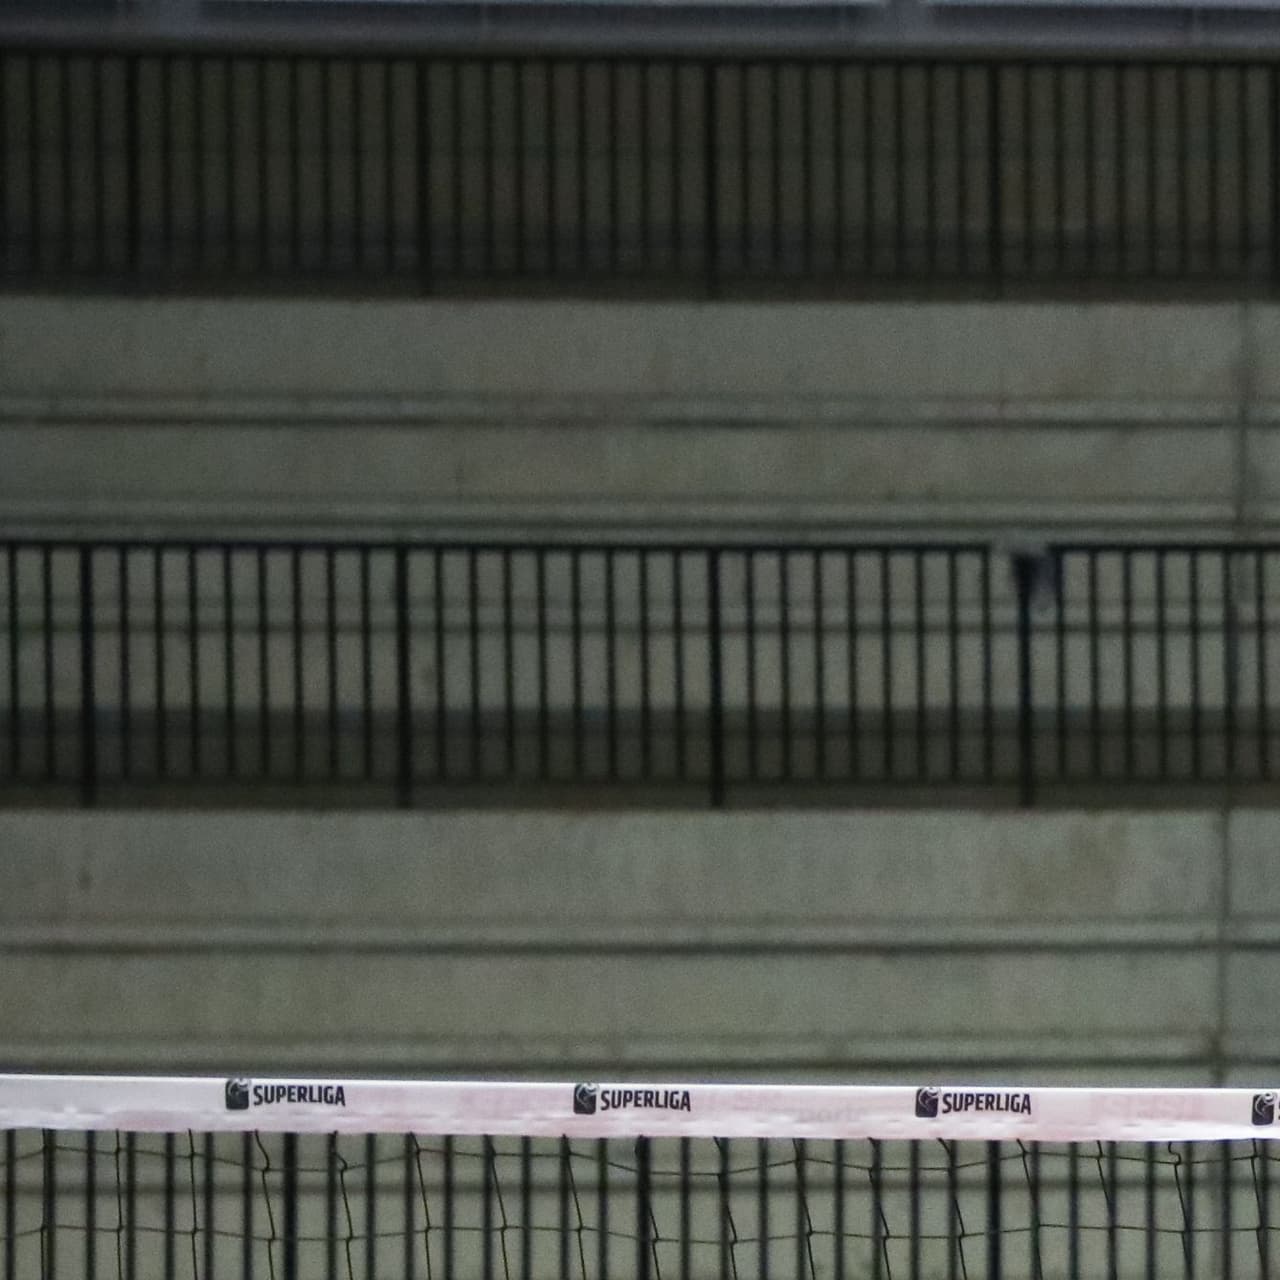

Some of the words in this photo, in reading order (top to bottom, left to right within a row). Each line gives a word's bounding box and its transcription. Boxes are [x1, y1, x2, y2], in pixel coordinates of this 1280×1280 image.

[254, 1086, 345, 1106] SUPERLIGA
[601, 1091, 690, 1111] SUPERLIGA
[943, 1094, 1031, 1114] SUPERLIGA
